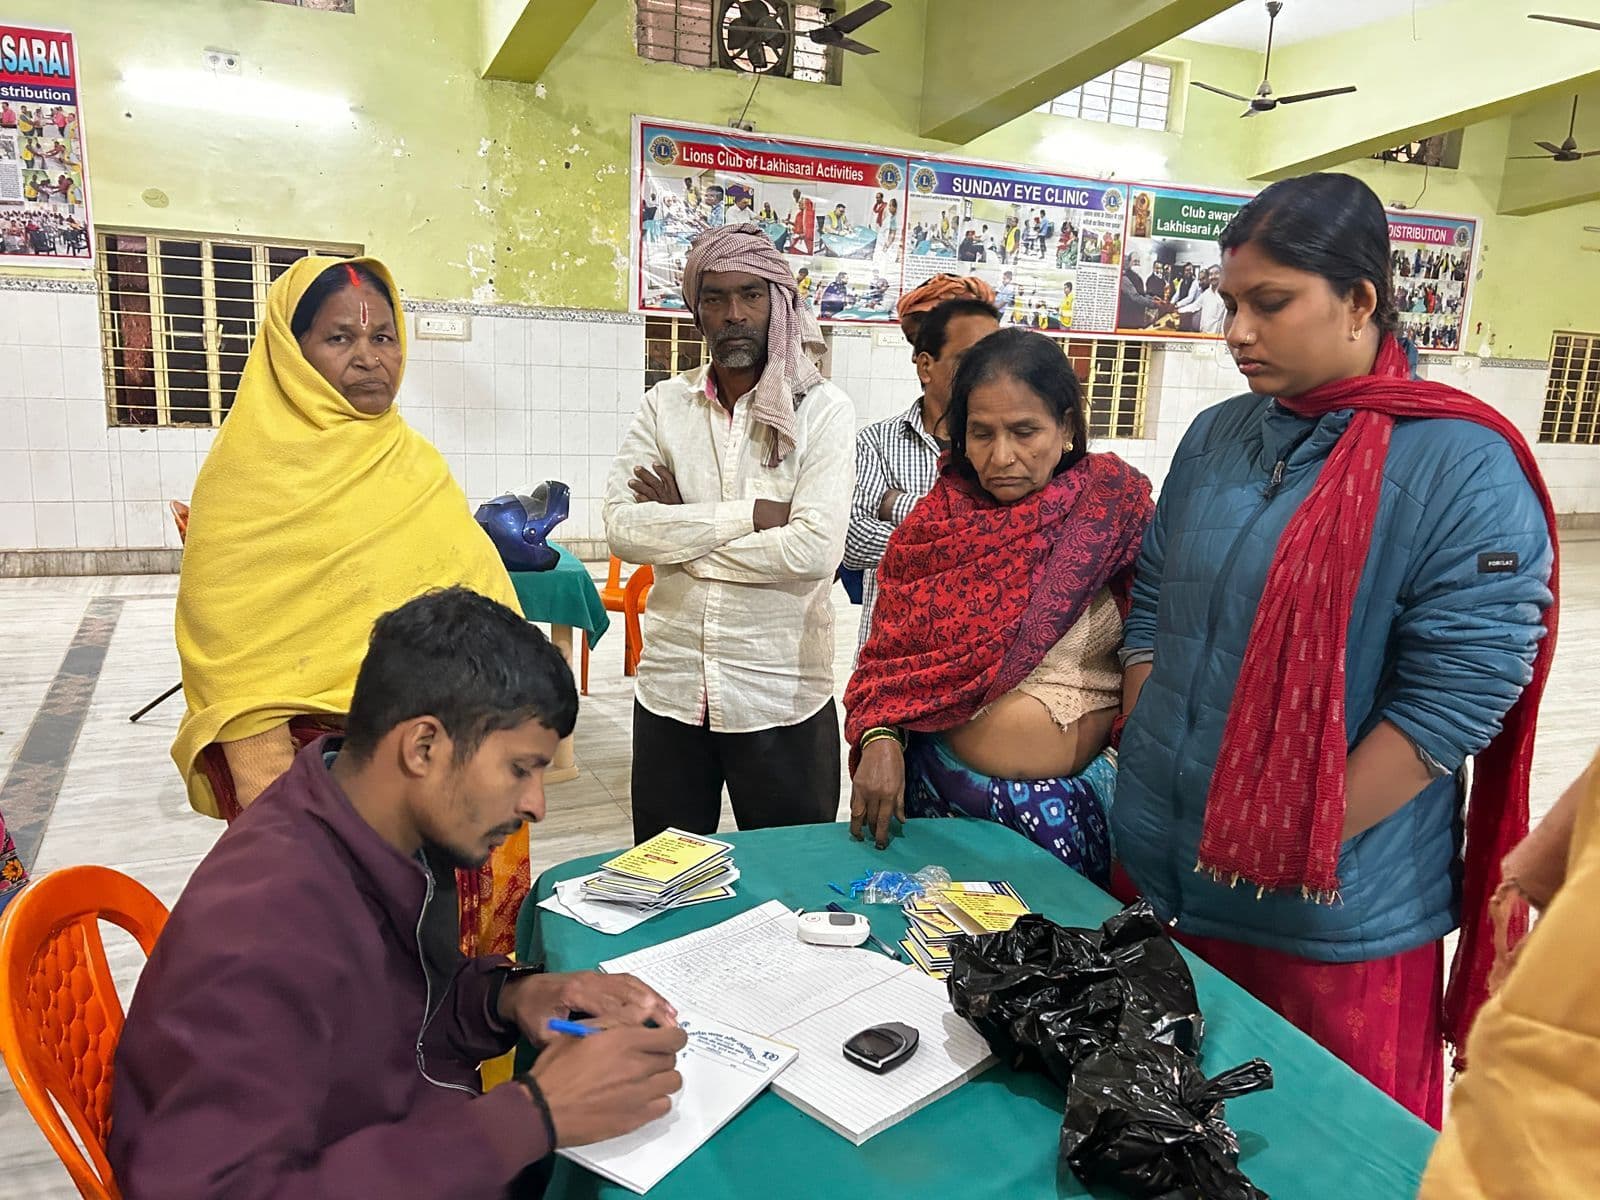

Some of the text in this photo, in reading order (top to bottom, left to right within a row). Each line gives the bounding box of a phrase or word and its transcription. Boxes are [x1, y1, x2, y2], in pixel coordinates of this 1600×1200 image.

[0, 34, 70, 77] SARAI
[0, 85, 71, 102] stribution
[682, 144, 864, 181] Lions Club of Lakhisarai Activities
[952, 177, 1011, 199] SUNDAY
[1014, 184, 1041, 202] EYE
[1044, 187, 1089, 207] CLINIC
[1181, 205, 1206, 220] Club
[1157, 218, 1211, 236] Lakhisarai
